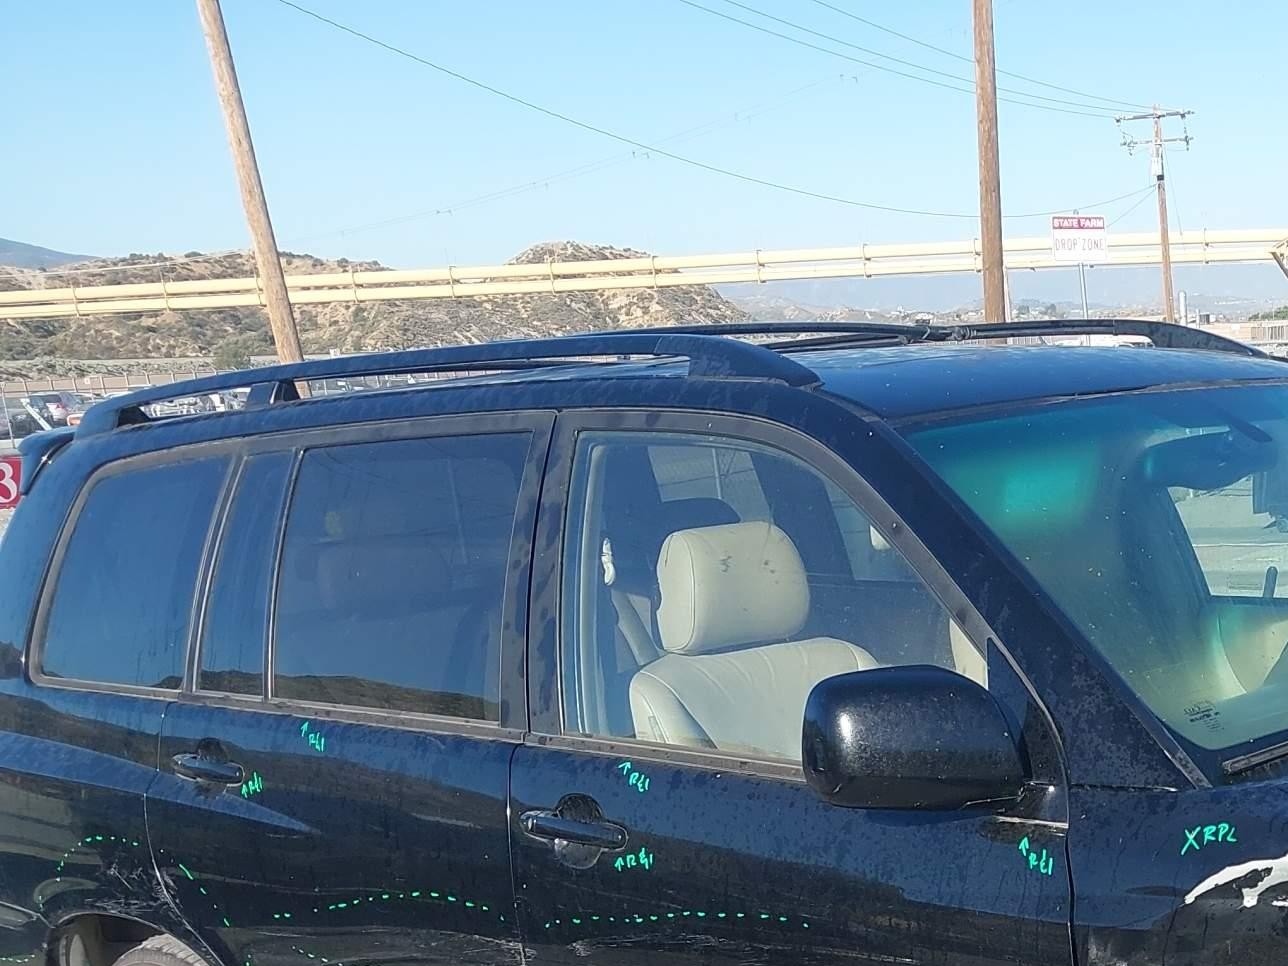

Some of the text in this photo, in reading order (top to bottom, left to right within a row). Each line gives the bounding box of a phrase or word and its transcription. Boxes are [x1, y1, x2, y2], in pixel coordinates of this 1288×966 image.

[1053, 218, 1104, 228] STATE FARM
[1055, 238, 1105, 250] DROP ZONE
